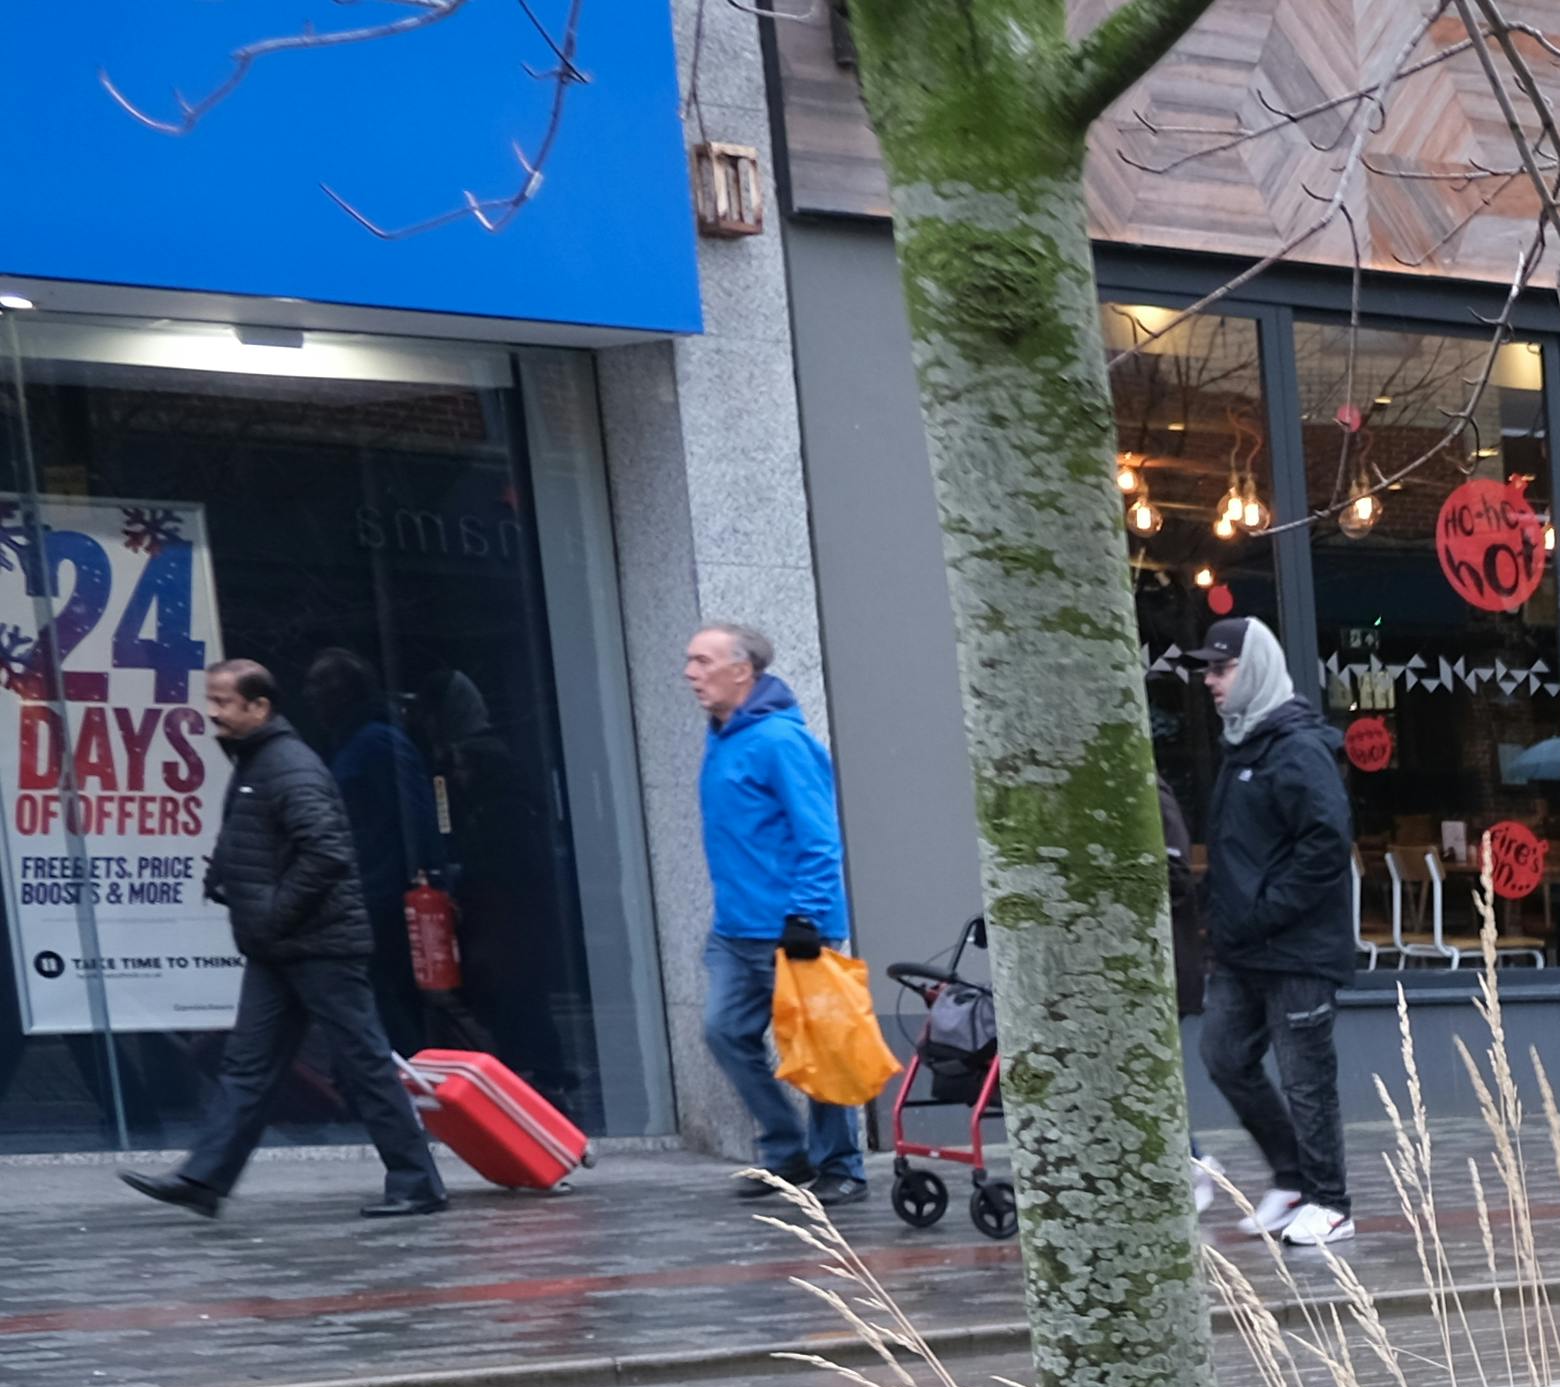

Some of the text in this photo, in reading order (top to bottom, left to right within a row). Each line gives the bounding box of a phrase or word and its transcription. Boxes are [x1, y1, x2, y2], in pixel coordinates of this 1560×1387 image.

[22, 530, 206, 704] 24
[18, 705, 206, 794] DAYS
[15, 794, 204, 836] OF OFFERS
[138, 856, 195, 879] PRICE
[106, 882, 123, 904] &
[129, 882, 184, 904] MORE
[122, 956, 162, 969] TIME
[166, 956, 189, 969] TO
[192, 955, 245, 969] THINK
